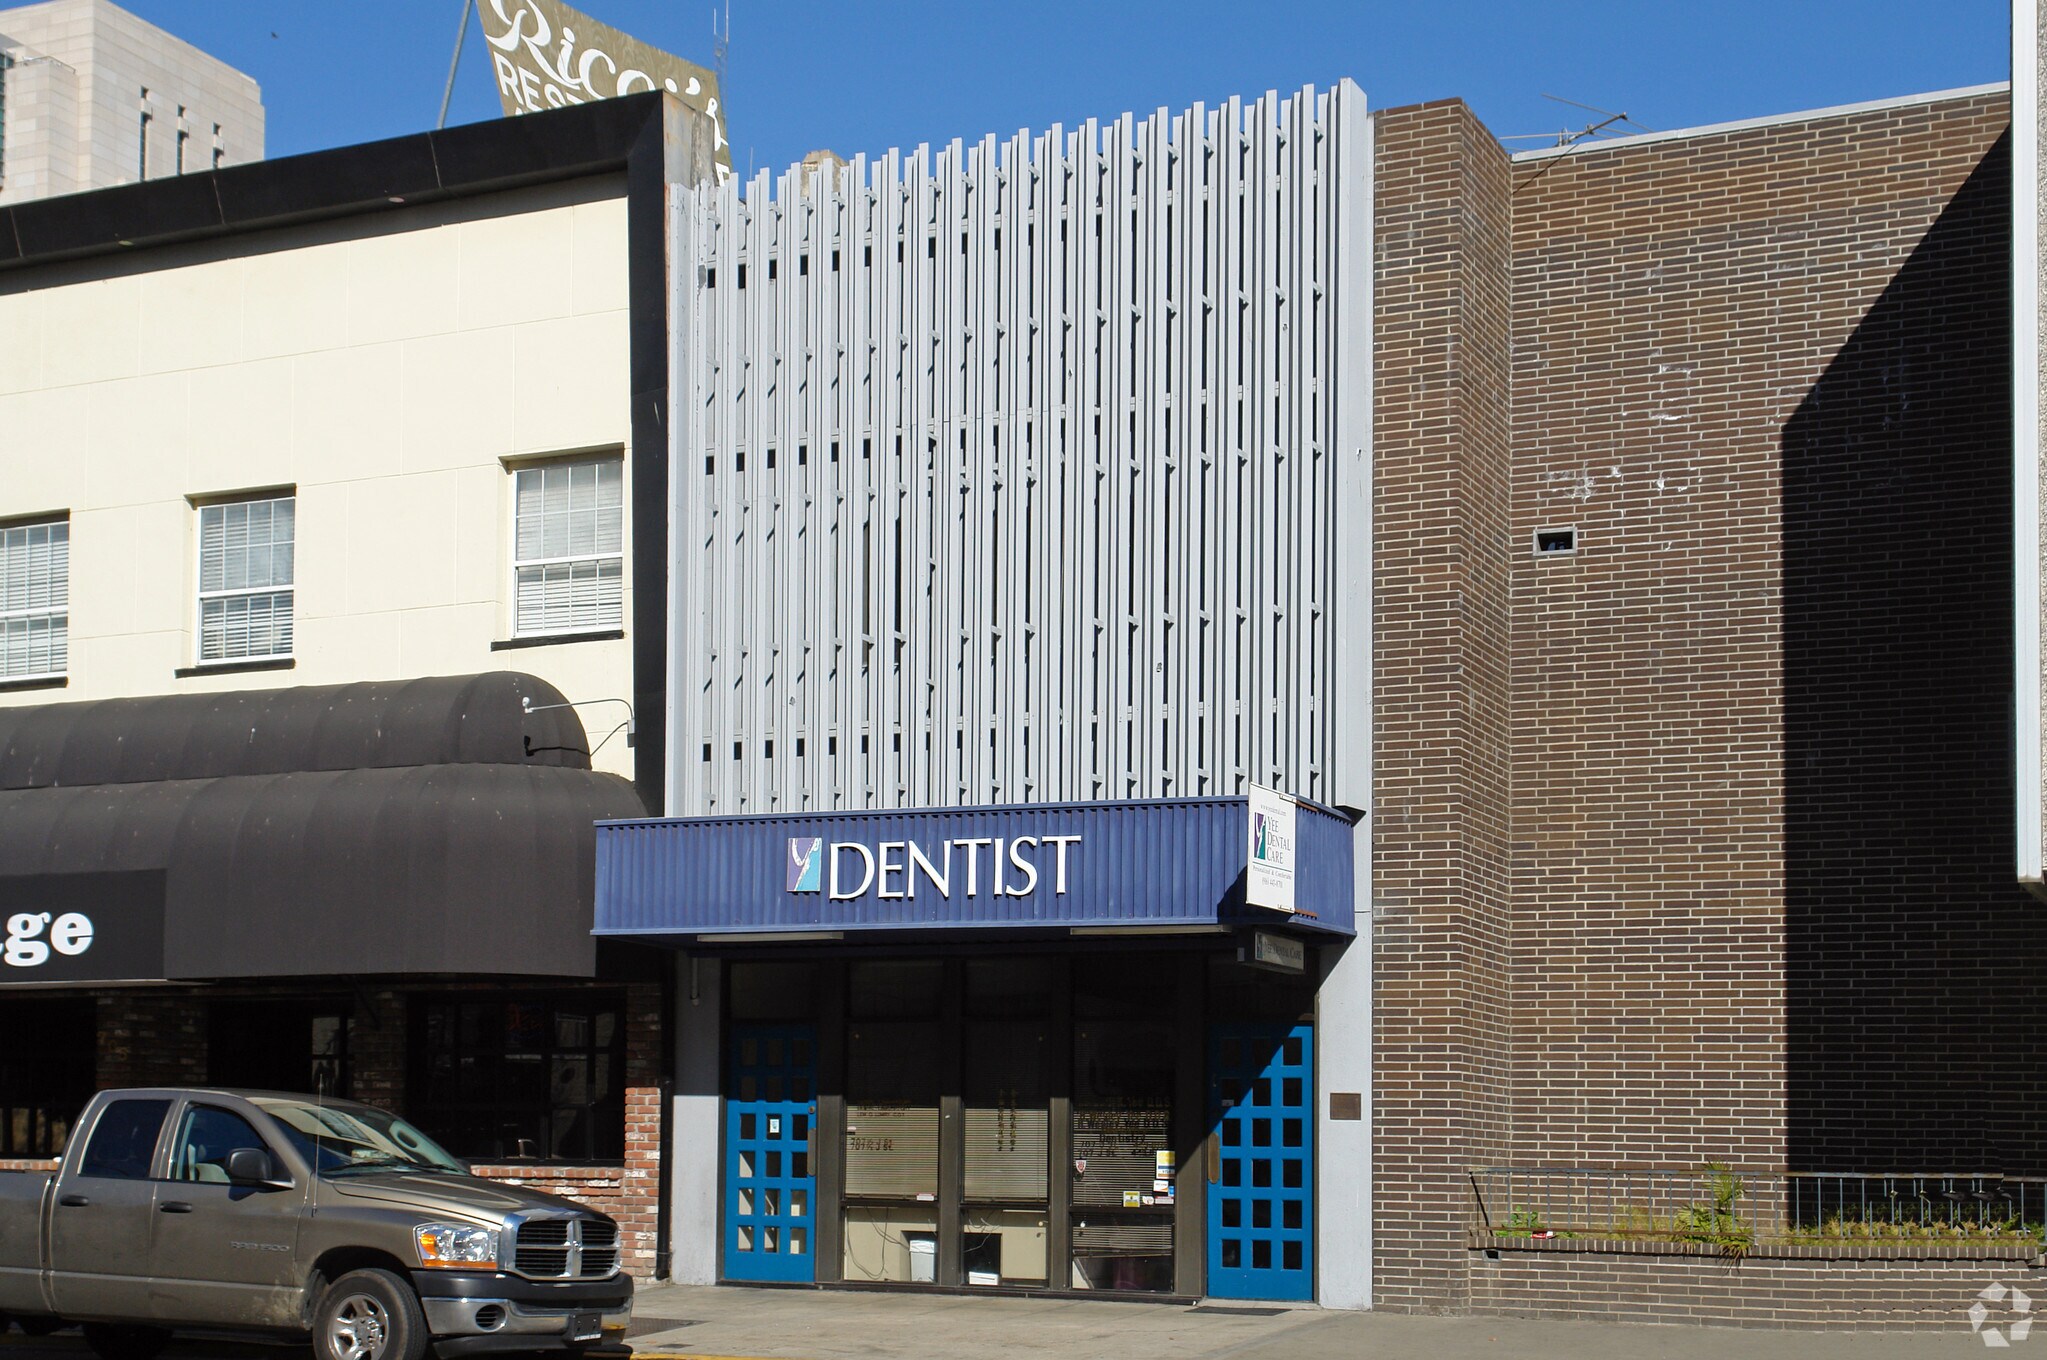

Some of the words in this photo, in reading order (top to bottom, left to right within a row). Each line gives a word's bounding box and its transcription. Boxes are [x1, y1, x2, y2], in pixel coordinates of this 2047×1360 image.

[1267, 831, 1291, 852] DENTAL
[1267, 847, 1284, 865] CARE
[828, 835, 1082, 900] DENTIST
[0, 911, 94, 967] ge
